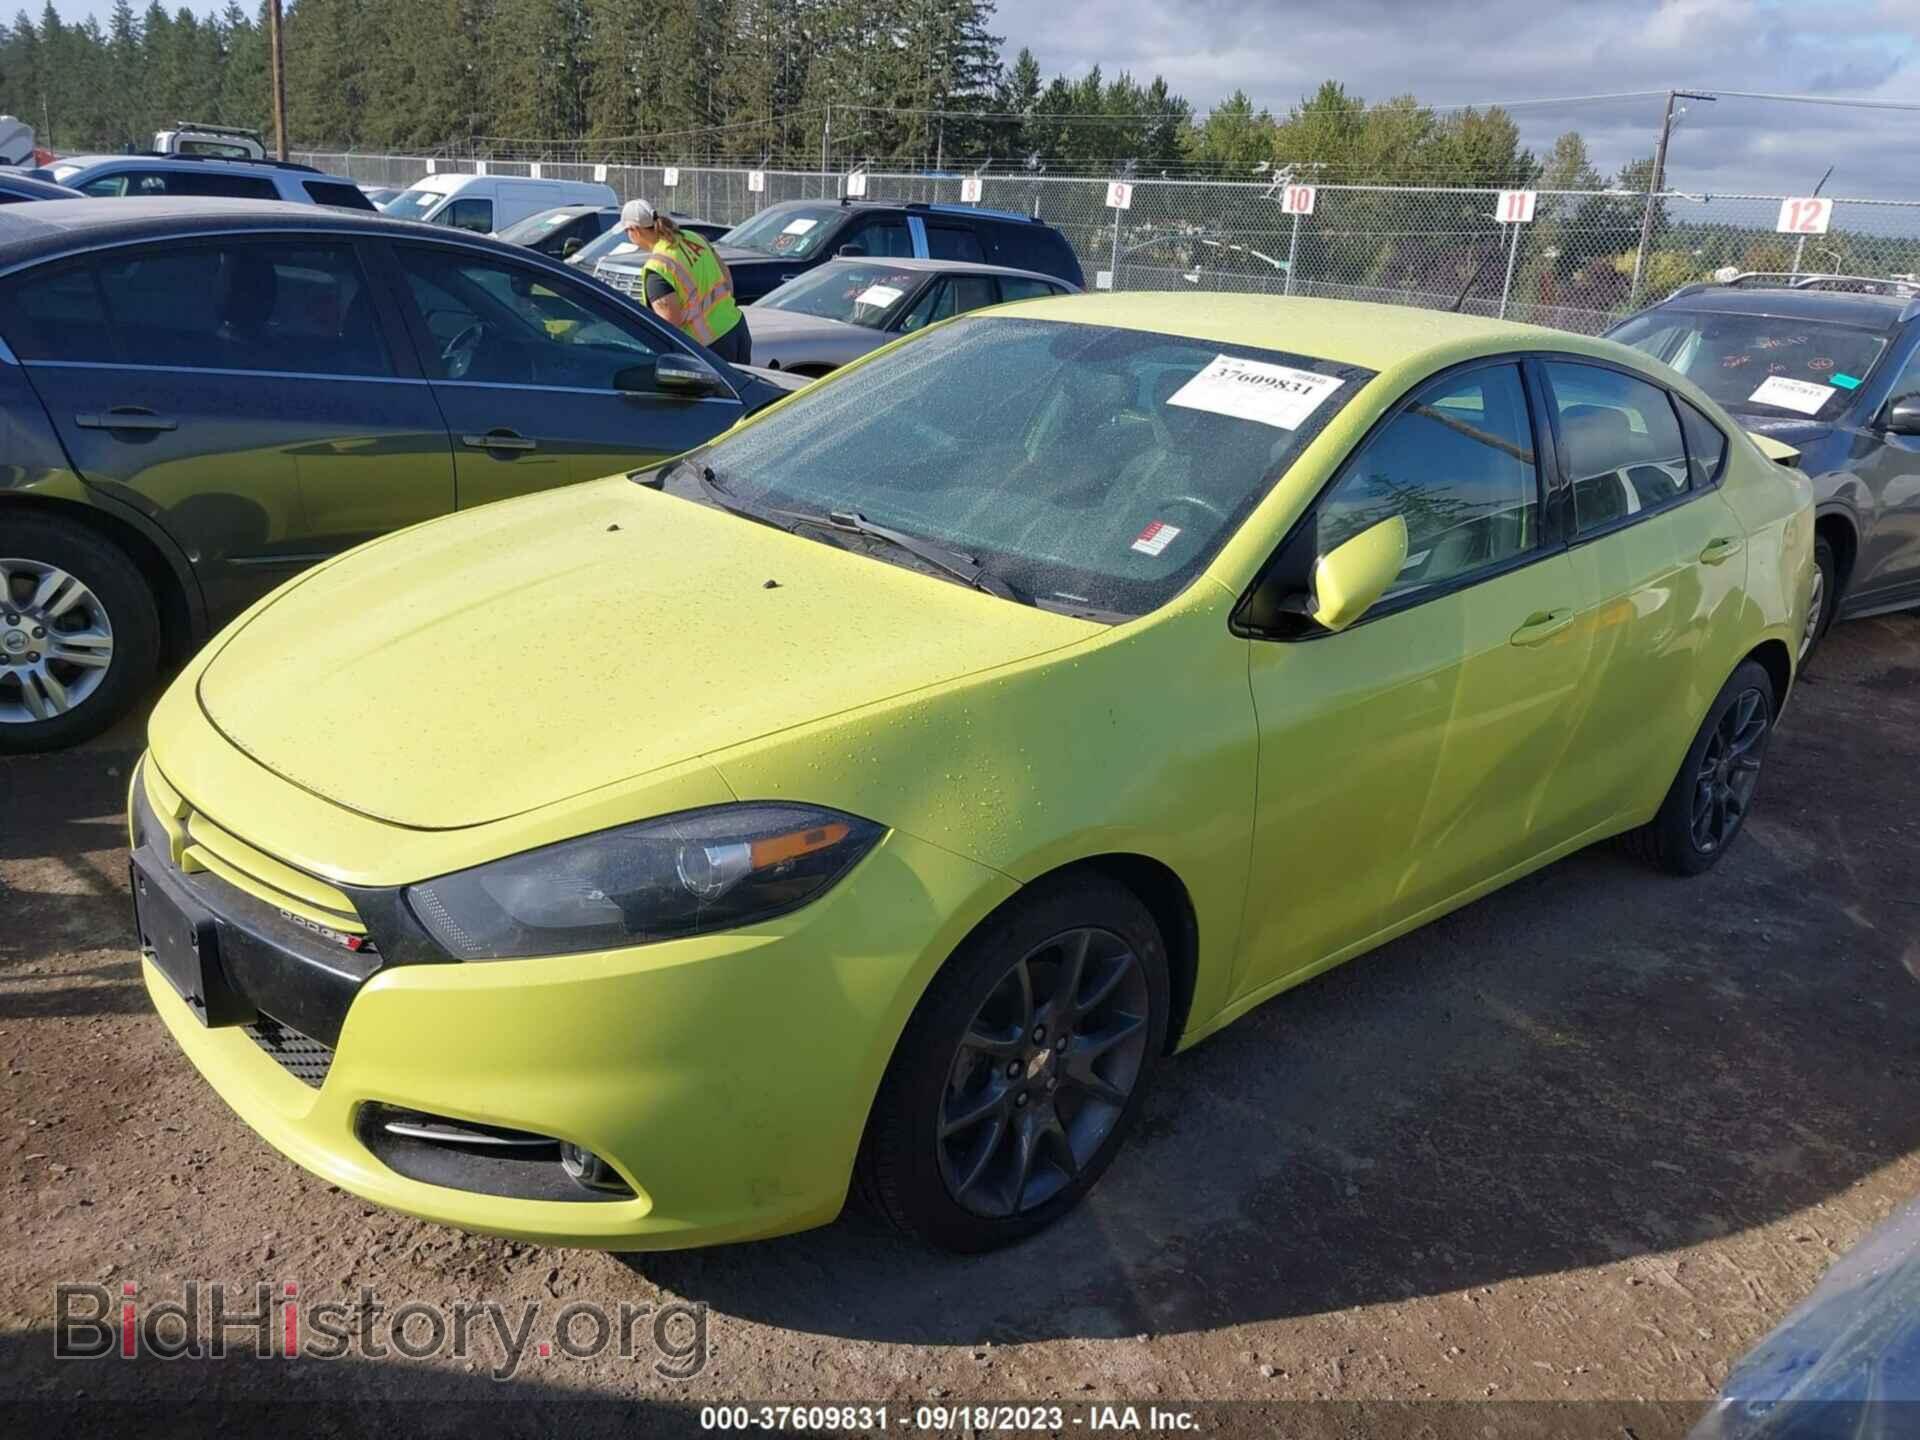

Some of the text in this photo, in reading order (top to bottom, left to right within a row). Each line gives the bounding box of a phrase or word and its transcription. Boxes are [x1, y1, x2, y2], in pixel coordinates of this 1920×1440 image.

[966, 181, 976, 200] 8
[1113, 184, 1125, 205] 9
[1289, 187, 1310, 212] 10
[1507, 193, 1527, 219] 11
[1789, 200, 1823, 231] 12
[1217, 367, 1313, 395] 37609831
